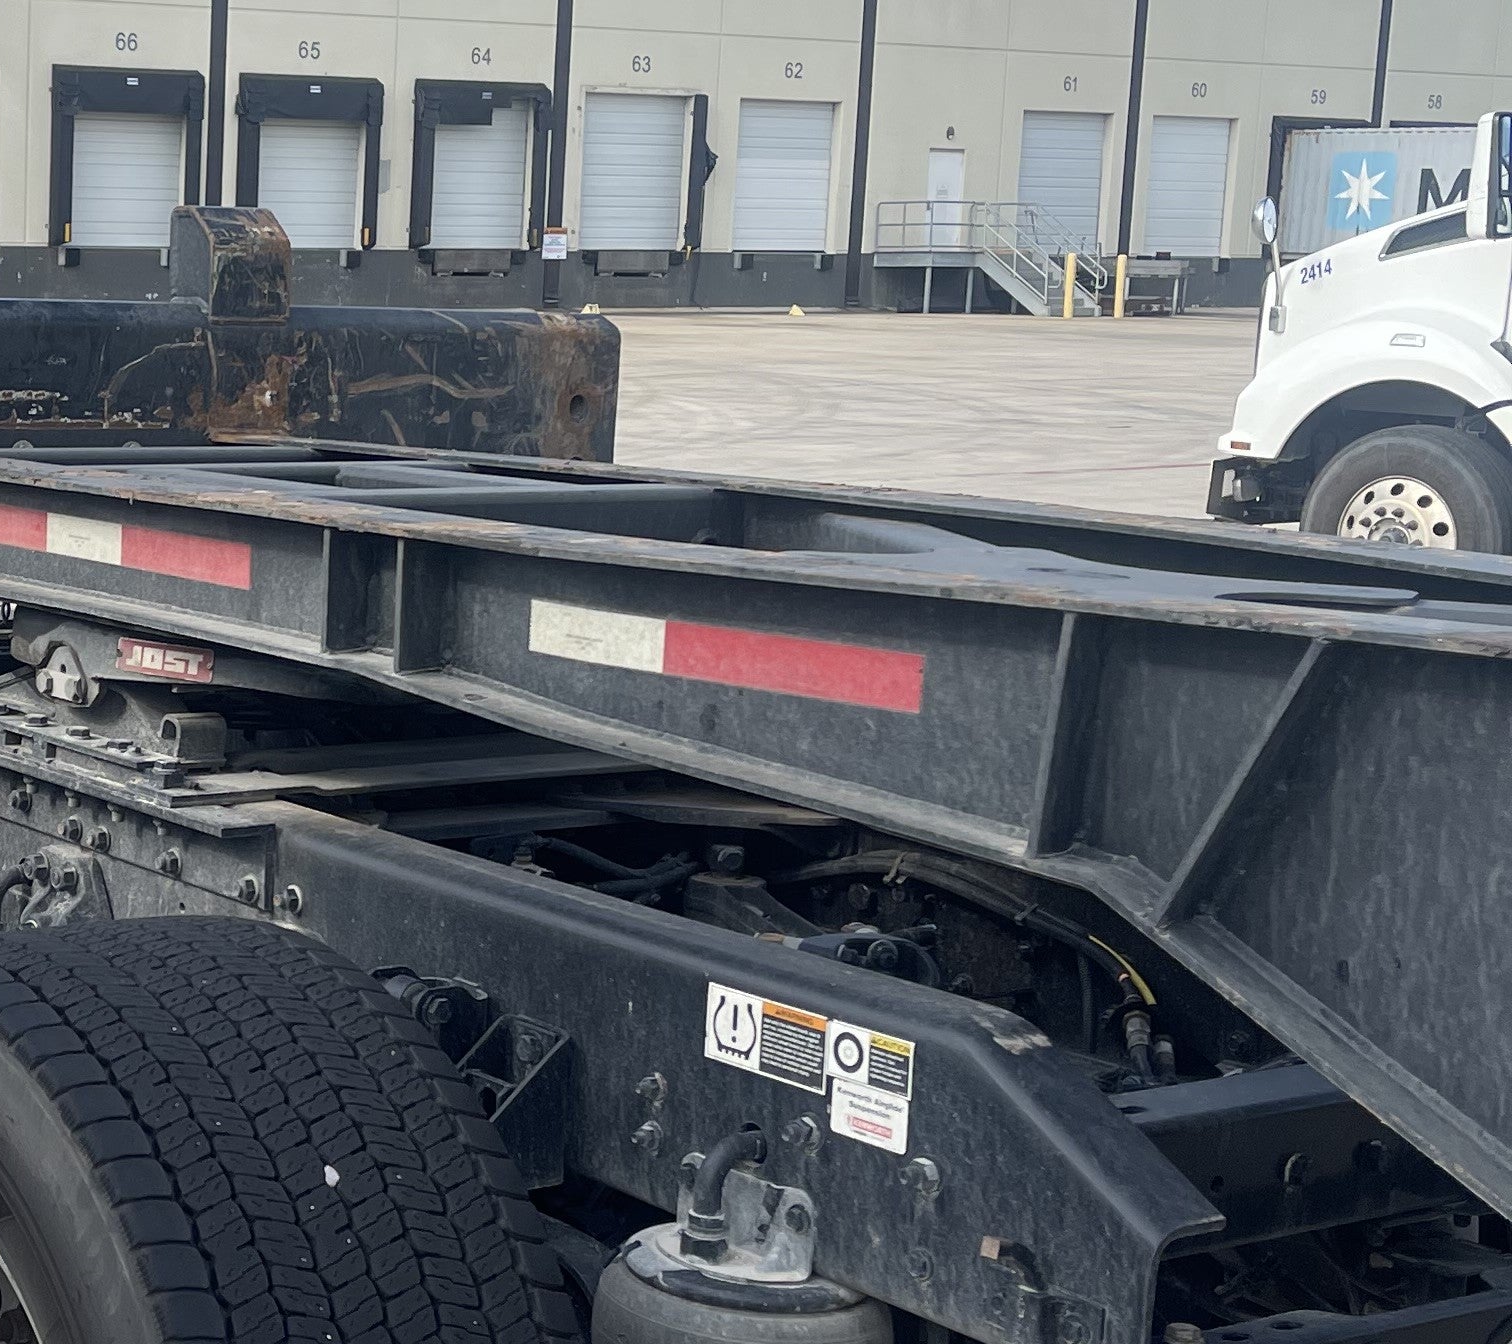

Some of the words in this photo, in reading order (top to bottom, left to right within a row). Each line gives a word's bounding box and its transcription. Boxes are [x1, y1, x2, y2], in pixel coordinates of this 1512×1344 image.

[115, 32, 138, 52] 66
[298, 40, 321, 60] 65
[471, 46, 492, 66] 64
[631, 55, 651, 74] 63
[784, 61, 804, 80] 62
[1063, 75, 1079, 93] 61
[1191, 82, 1208, 98] 60
[1310, 89, 1327, 105] 59
[1427, 94, 1443, 110] 58
[1300, 258, 1333, 285] 2414
[126, 645, 204, 676] JOST
[876, 1038, 911, 1054] CAUTION
